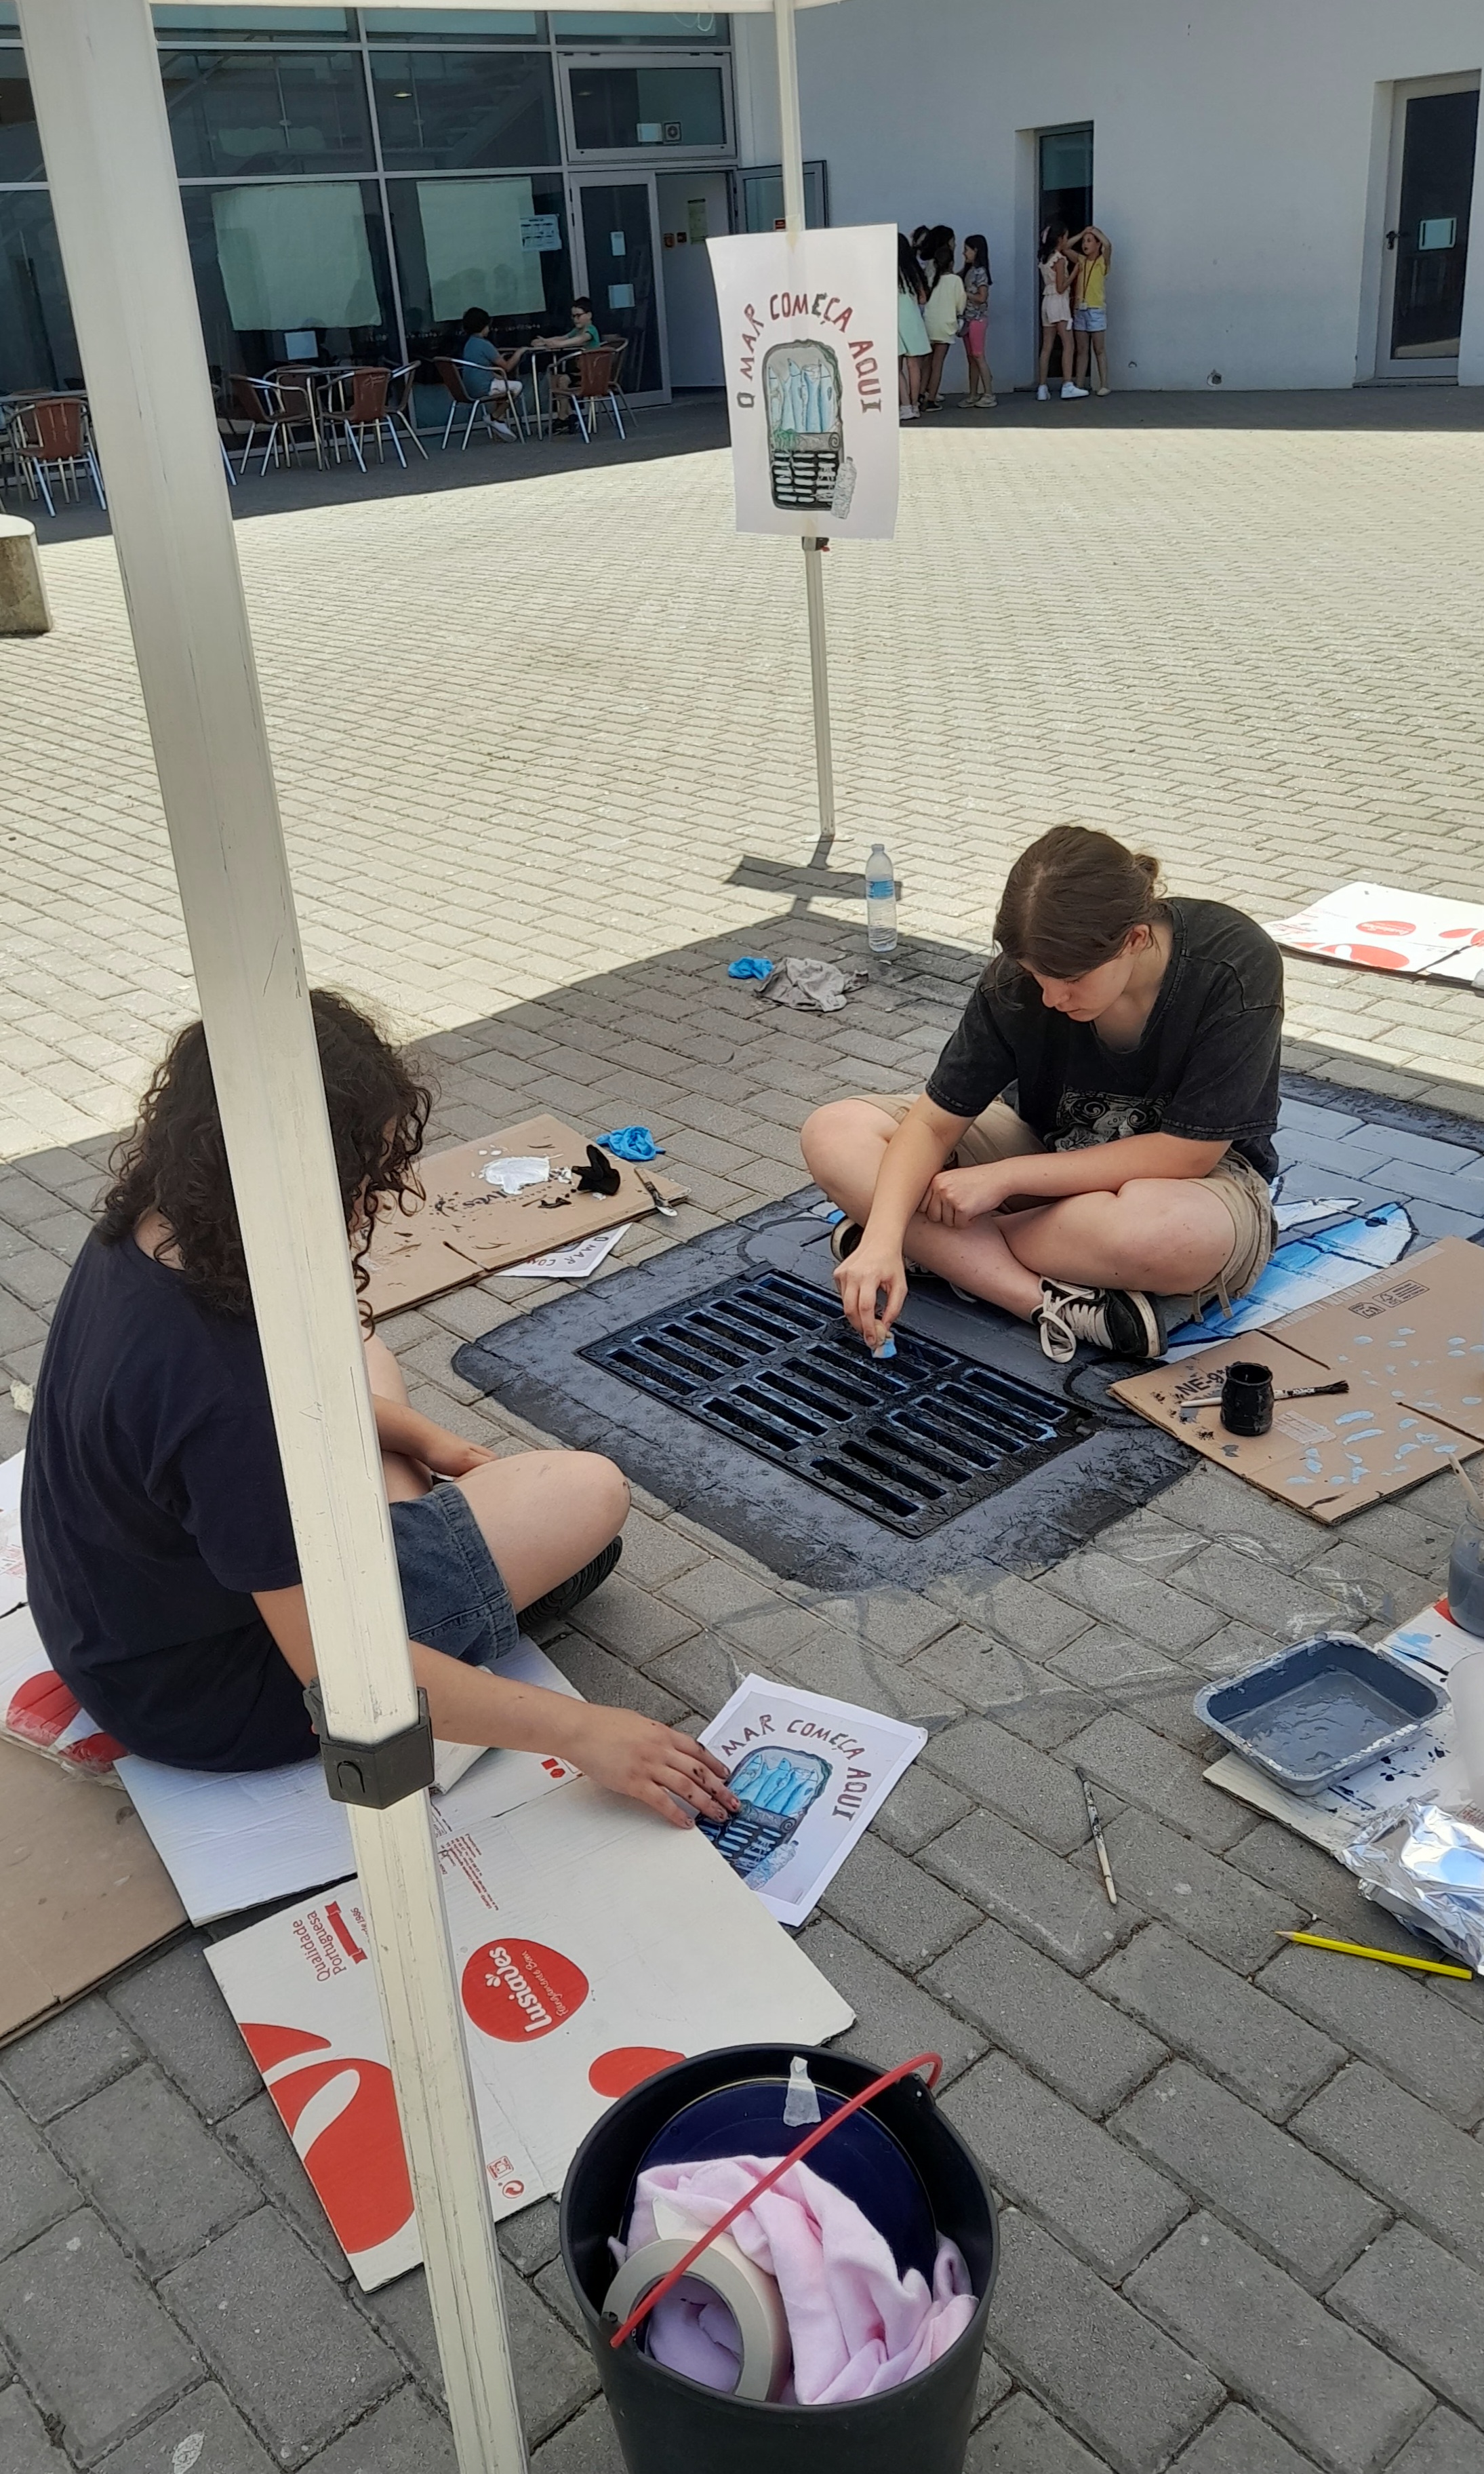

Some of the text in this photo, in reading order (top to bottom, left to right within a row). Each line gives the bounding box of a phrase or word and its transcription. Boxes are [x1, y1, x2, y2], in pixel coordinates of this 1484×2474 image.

[736, 292, 882, 414] O MAR COMEÇA AQUI
[563, 1244, 597, 1265] MAR
[721, 1714, 873, 1822] MAR COMEÇA AQUI
[307, 1910, 347, 1976] Portuguesa
[350, 1907, 365, 1924] 1986
[292, 1919, 331, 1982] Qualidade
[521, 1950, 538, 1971] Bom
